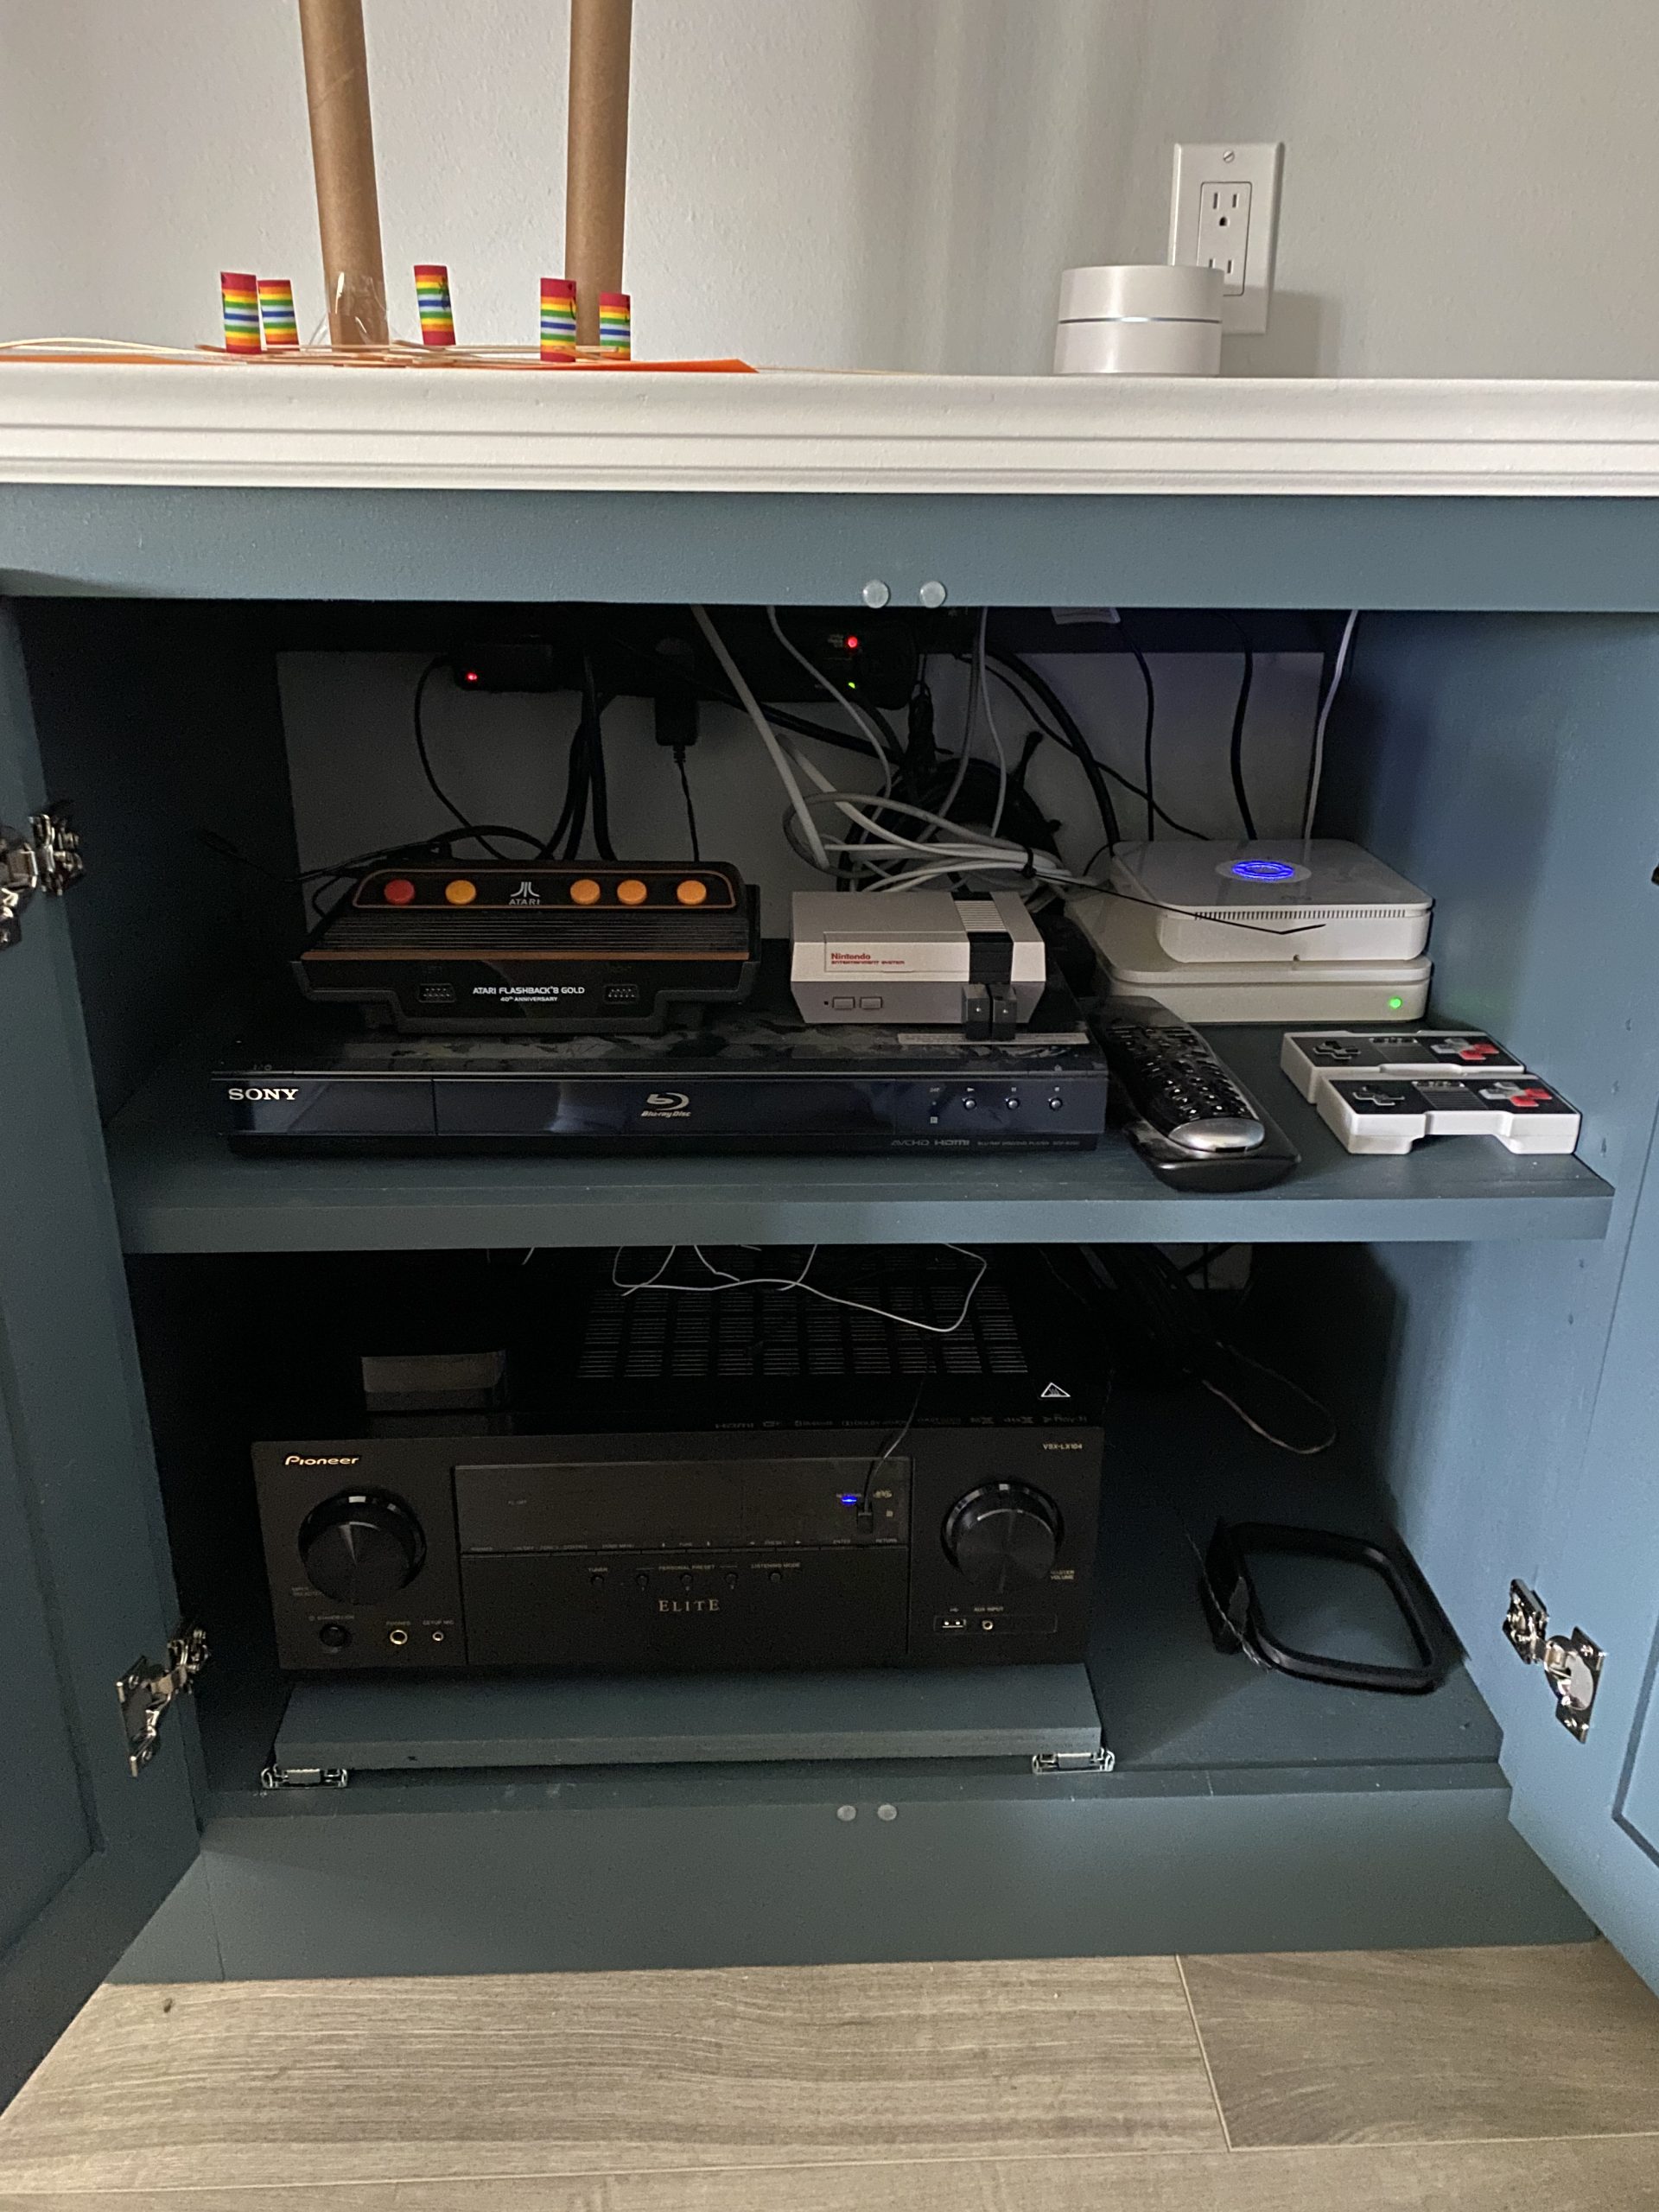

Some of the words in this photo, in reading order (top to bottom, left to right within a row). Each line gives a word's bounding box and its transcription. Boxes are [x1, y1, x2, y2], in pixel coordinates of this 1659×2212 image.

[472, 986, 497, 995] ATARI
[561, 986, 585, 995] GOLD
[227, 1087, 300, 1101] SONY
[284, 1455, 360, 1465] Pioneer
[658, 1599, 721, 1613] ELITE
